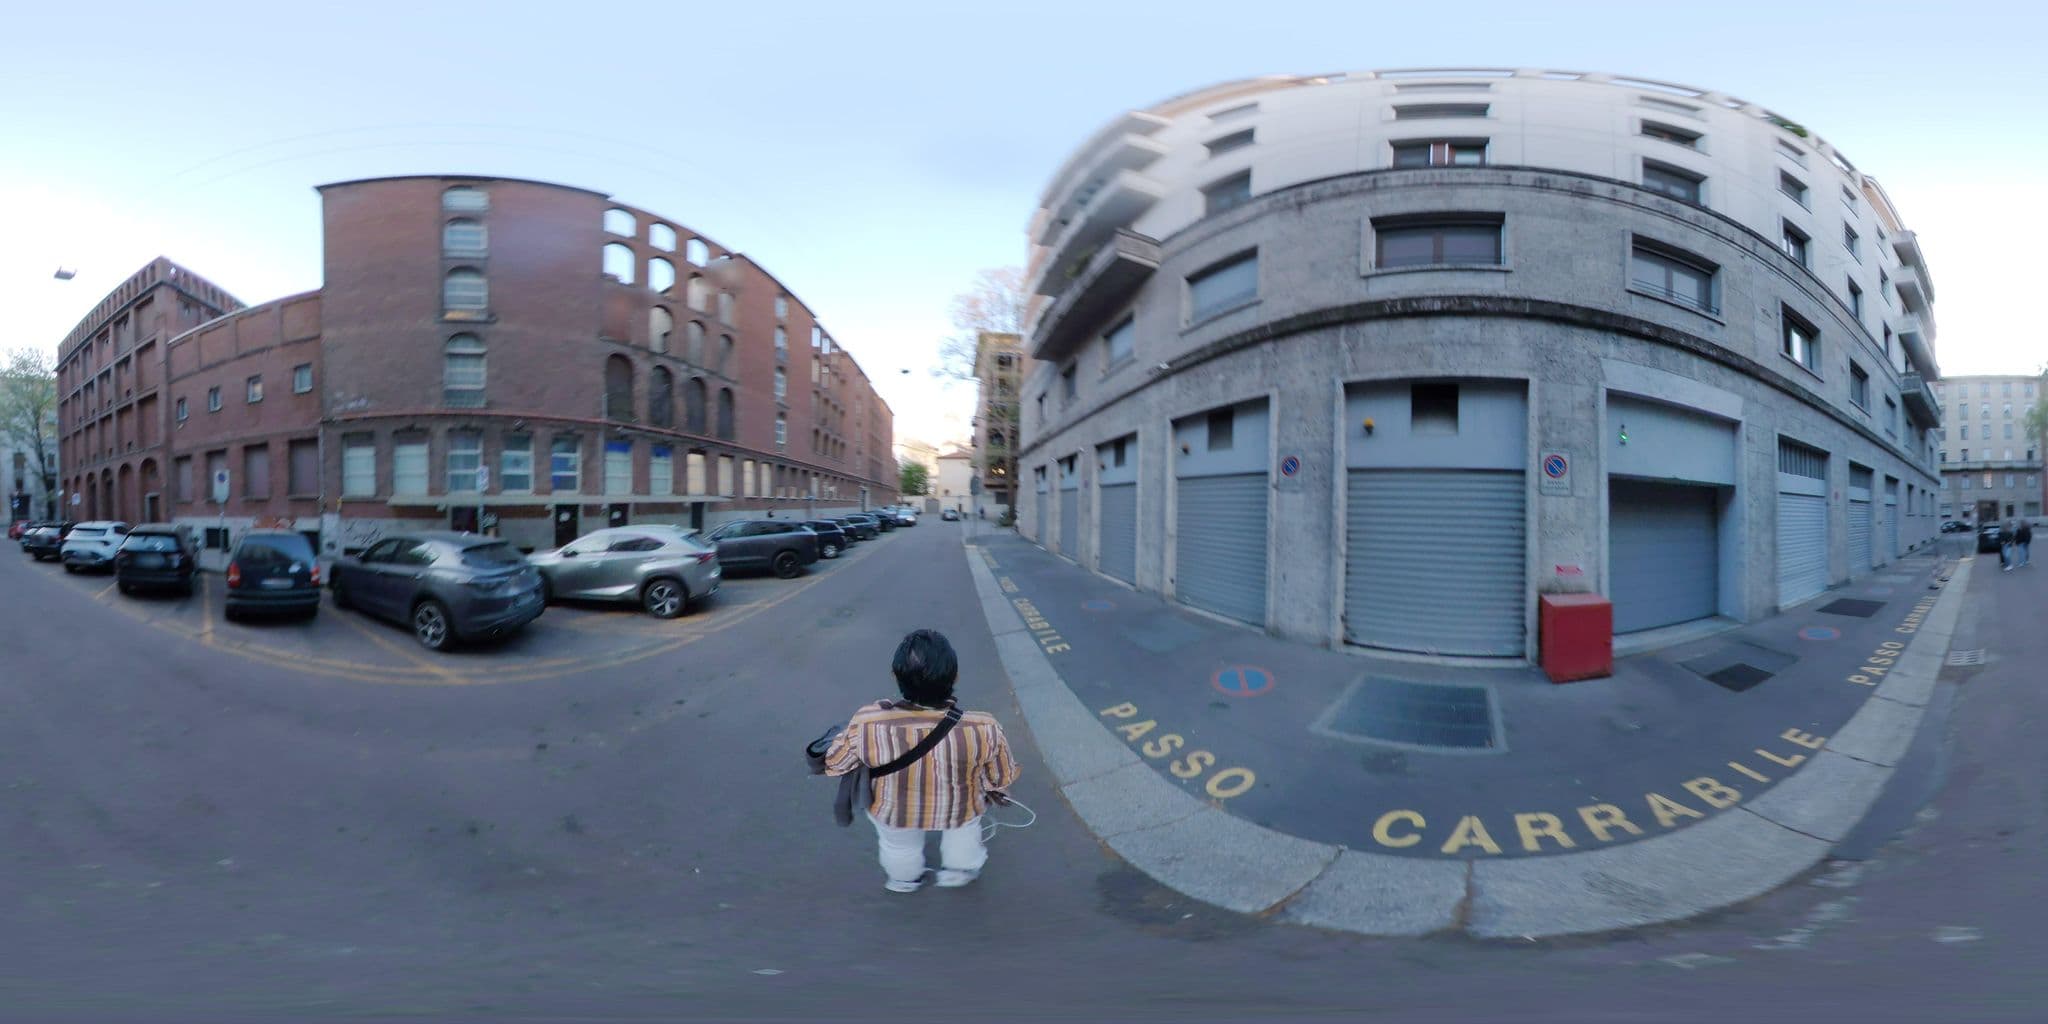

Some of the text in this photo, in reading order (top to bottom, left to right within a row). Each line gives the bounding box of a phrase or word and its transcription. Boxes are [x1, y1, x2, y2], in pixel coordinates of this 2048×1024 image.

[1847, 640, 1905, 687] PASSO
[1100, 701, 1827, 855] PASSO CARRABILE
